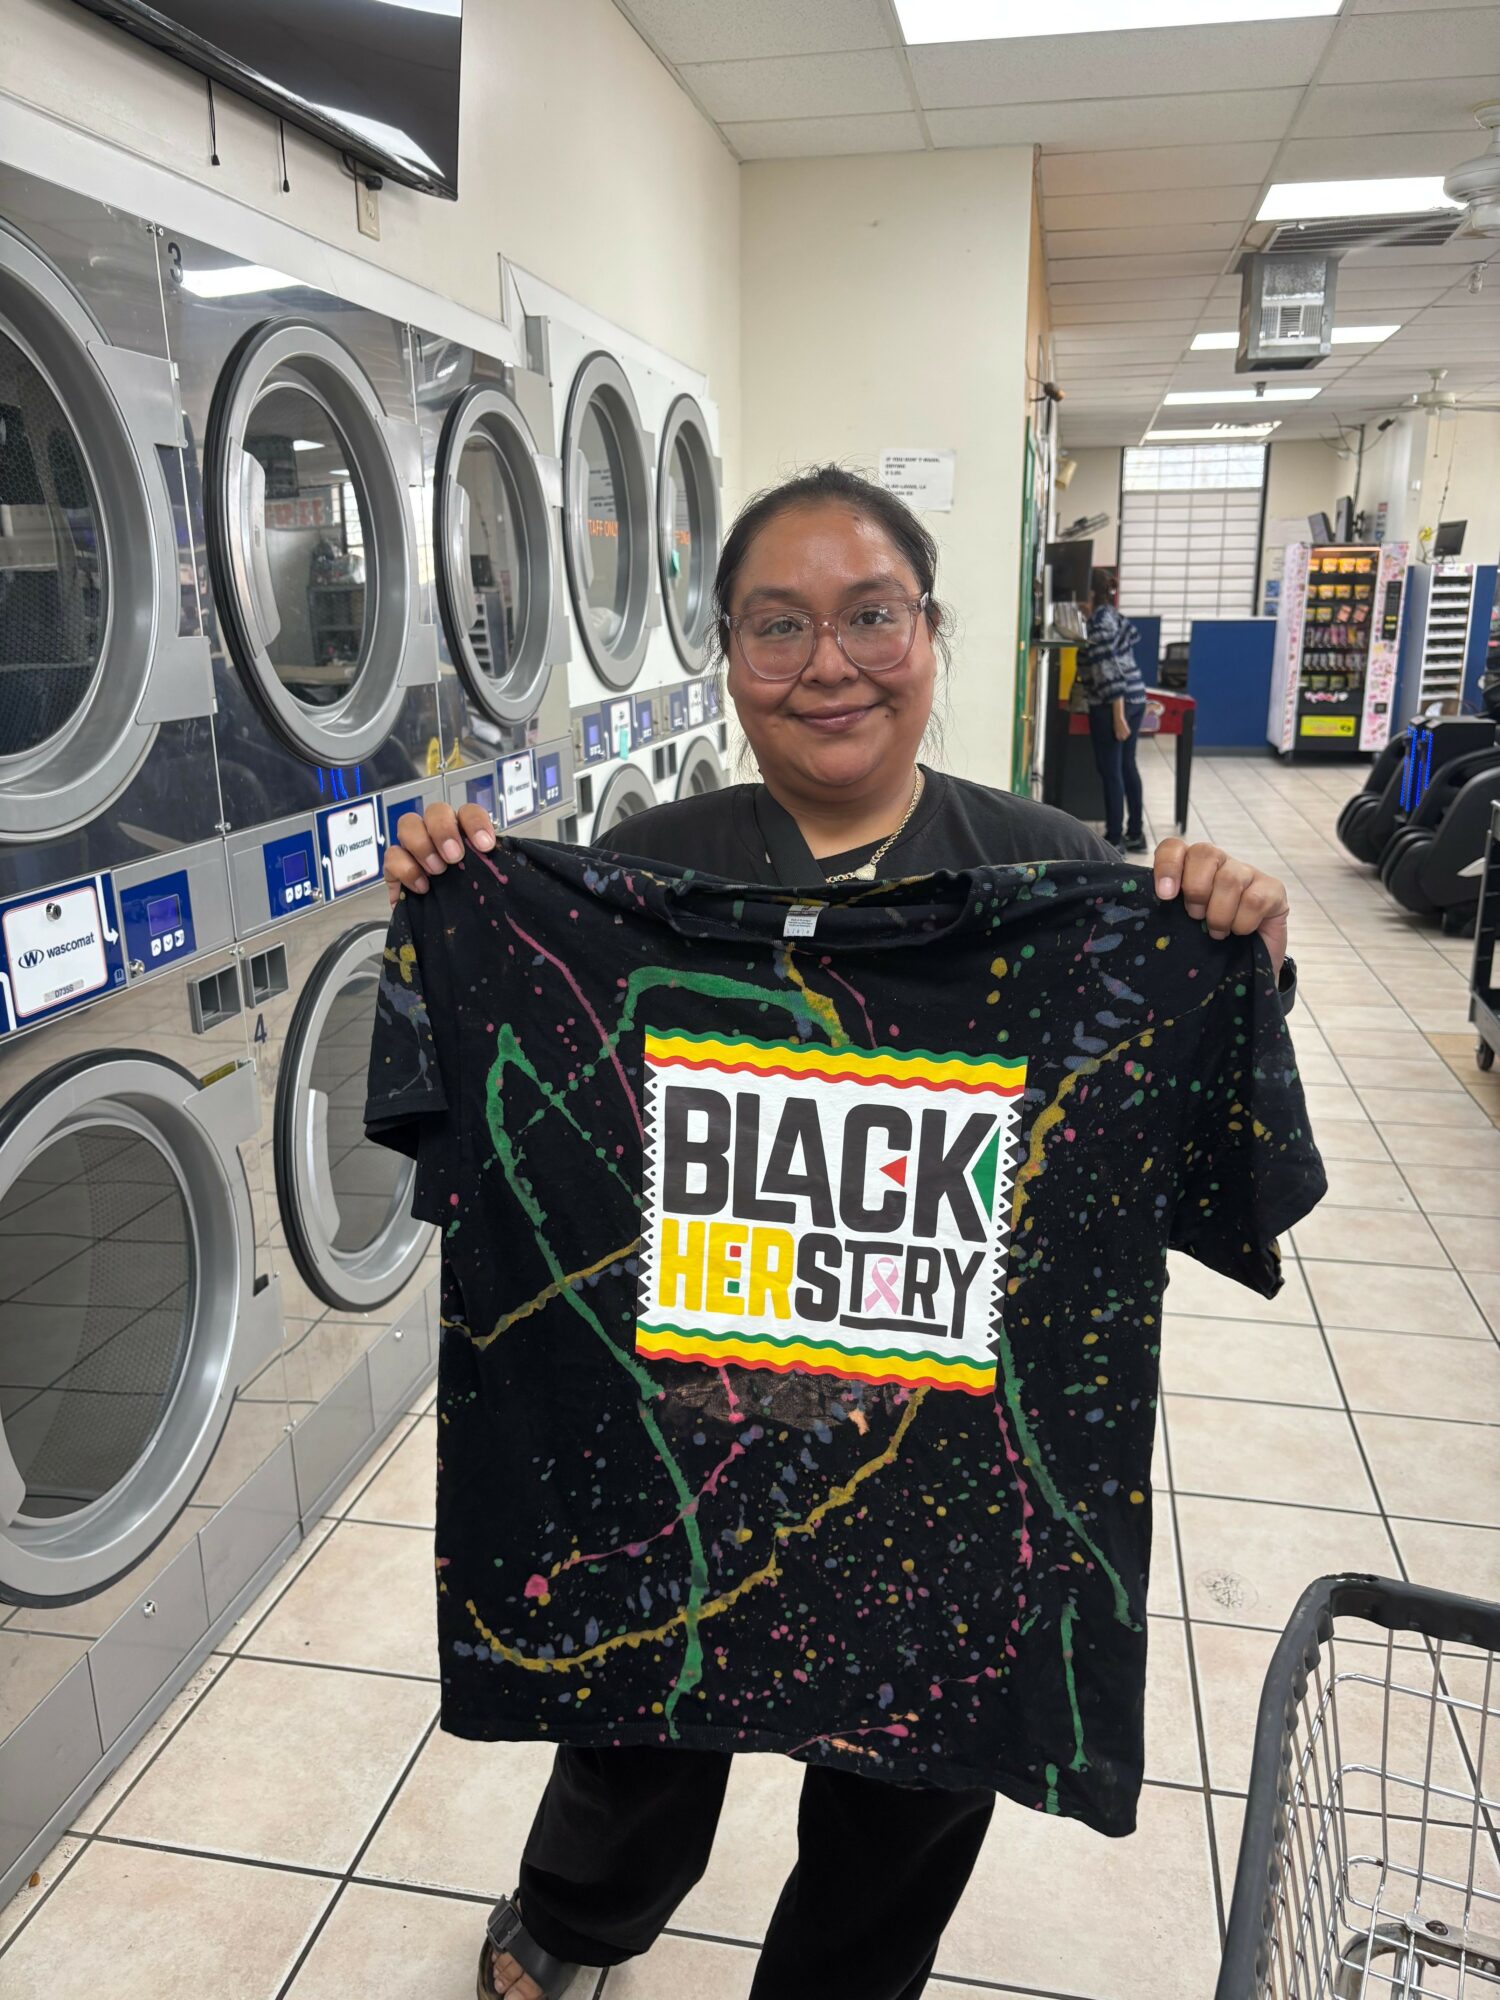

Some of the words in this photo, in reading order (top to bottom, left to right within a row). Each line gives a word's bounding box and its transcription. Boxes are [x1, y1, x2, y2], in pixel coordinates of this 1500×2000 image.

[168, 242, 183, 284] 3
[46, 932, 95, 959] wascomat
[254, 1013, 267, 1043] 4
[662, 1085, 998, 1243] BLACK
